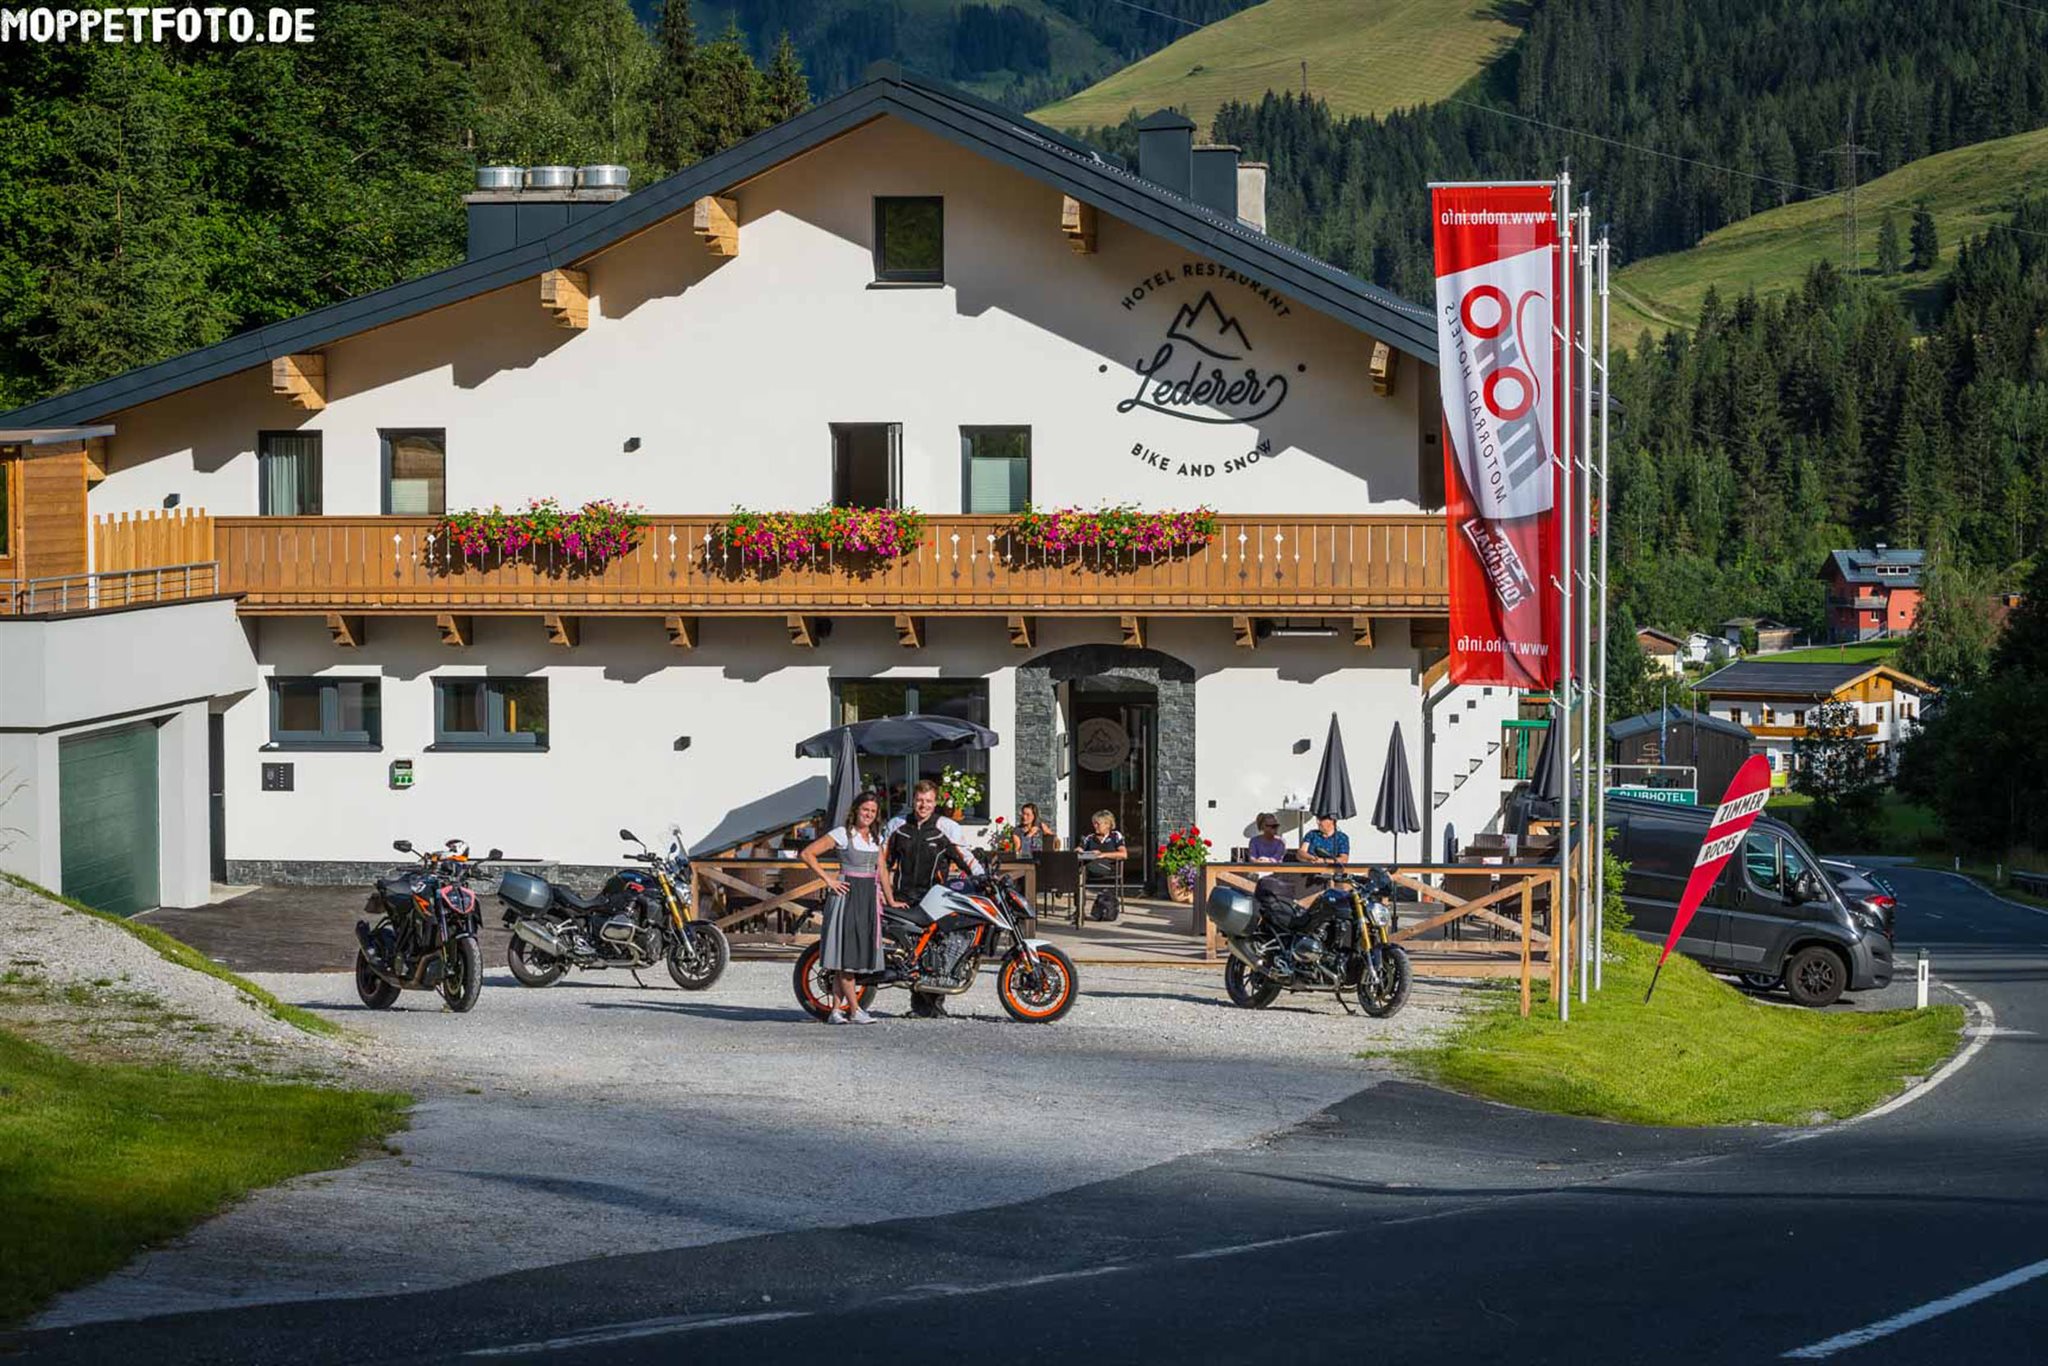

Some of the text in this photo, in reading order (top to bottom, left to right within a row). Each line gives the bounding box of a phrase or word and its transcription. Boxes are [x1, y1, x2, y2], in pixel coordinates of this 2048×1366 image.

[1121, 263, 1291, 318] HOTEL RESTAURANT
[1117, 343, 1288, 425] Lederer
[1130, 438, 1272, 477] BIKE AND SNOW
[1718, 792, 1765, 823] ZIMMER
[1702, 834, 1738, 862] ROOMS
